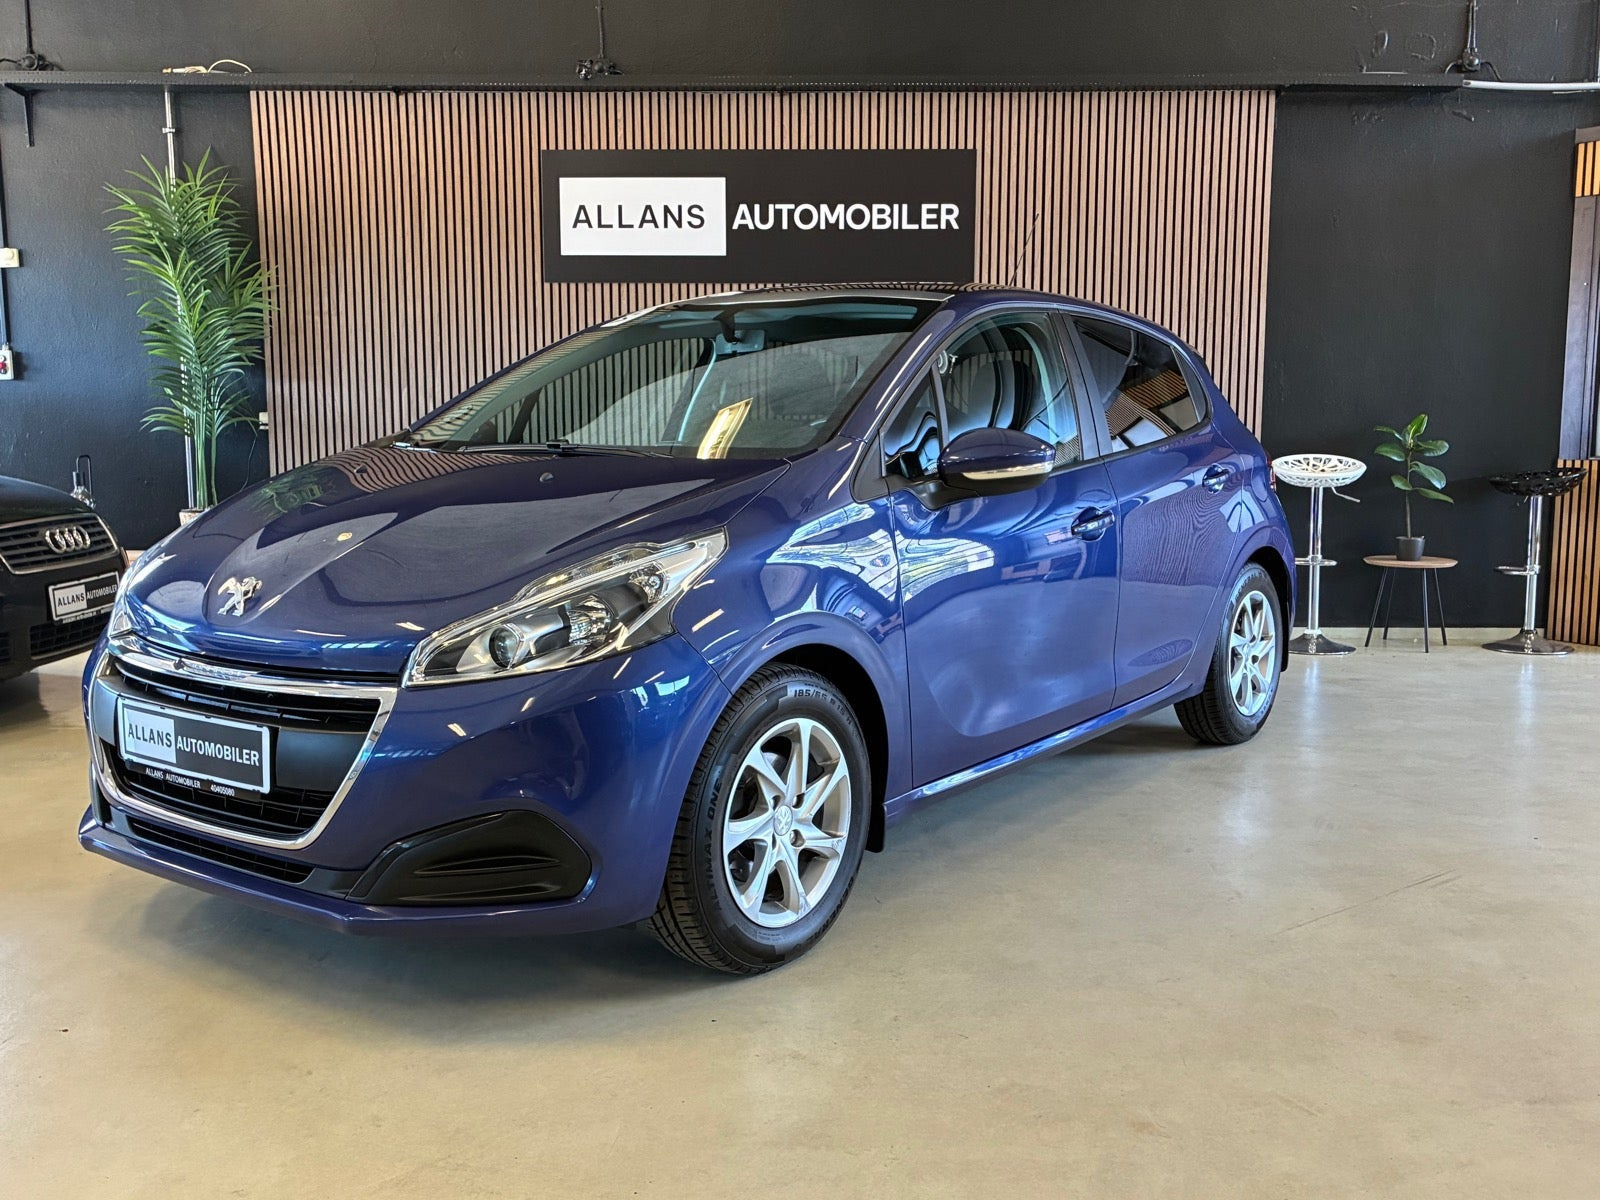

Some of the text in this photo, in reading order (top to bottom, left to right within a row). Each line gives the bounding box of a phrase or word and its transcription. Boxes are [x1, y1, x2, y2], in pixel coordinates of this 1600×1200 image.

[572, 203, 960, 231] ALLANS AUTOMOBILER
[57, 584, 118, 608] ALLANS AUTOMOBILER
[127, 723, 260, 767] ALLANS AUTOMOBILER
[145, 767, 164, 779] ALLANS
[165, 773, 201, 788] AUTOMOBILER
[707, 778, 722, 820] ONE
